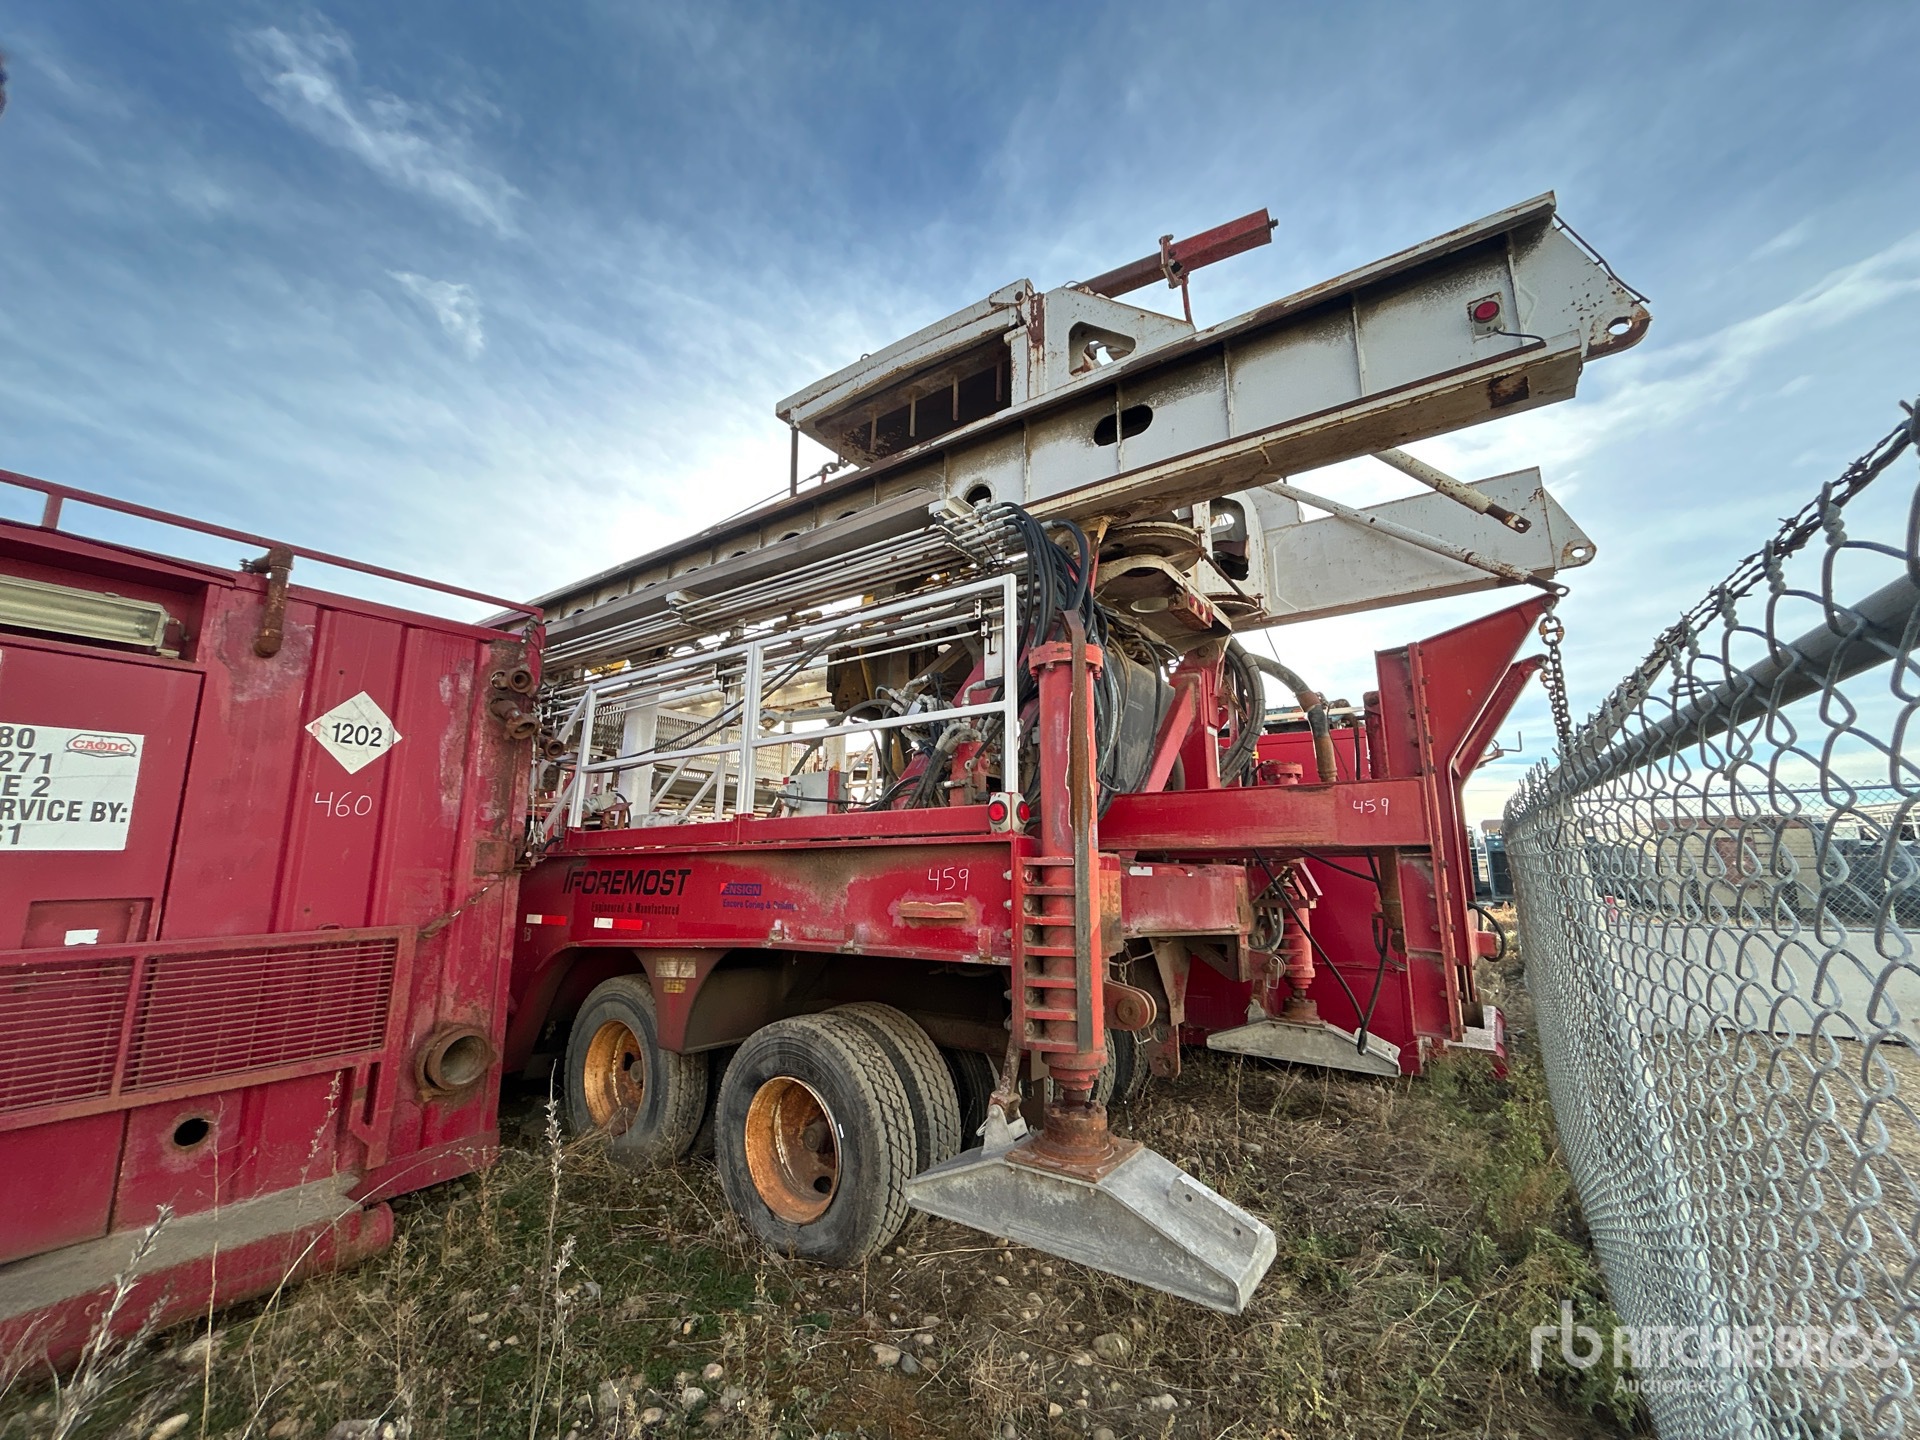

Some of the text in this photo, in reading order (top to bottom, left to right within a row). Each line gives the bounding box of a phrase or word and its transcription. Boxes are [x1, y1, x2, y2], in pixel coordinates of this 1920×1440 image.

[0, 726, 36, 750] 80
[72, 740, 131, 752] CAODC
[332, 722, 383, 748] 1202
[0, 750, 53, 775] 271
[30, 776, 51, 798] 2
[0, 798, 128, 823] RVICE BY:
[315, 791, 373, 818] 460
[1352, 797, 1390, 816] 459
[562, 867, 692, 896] FOREMOST
[723, 884, 761, 896] ENSIGN
[928, 867, 970, 892] 459
[627, 902, 633, 914] &
[634, 902, 681, 916] Manufactured
